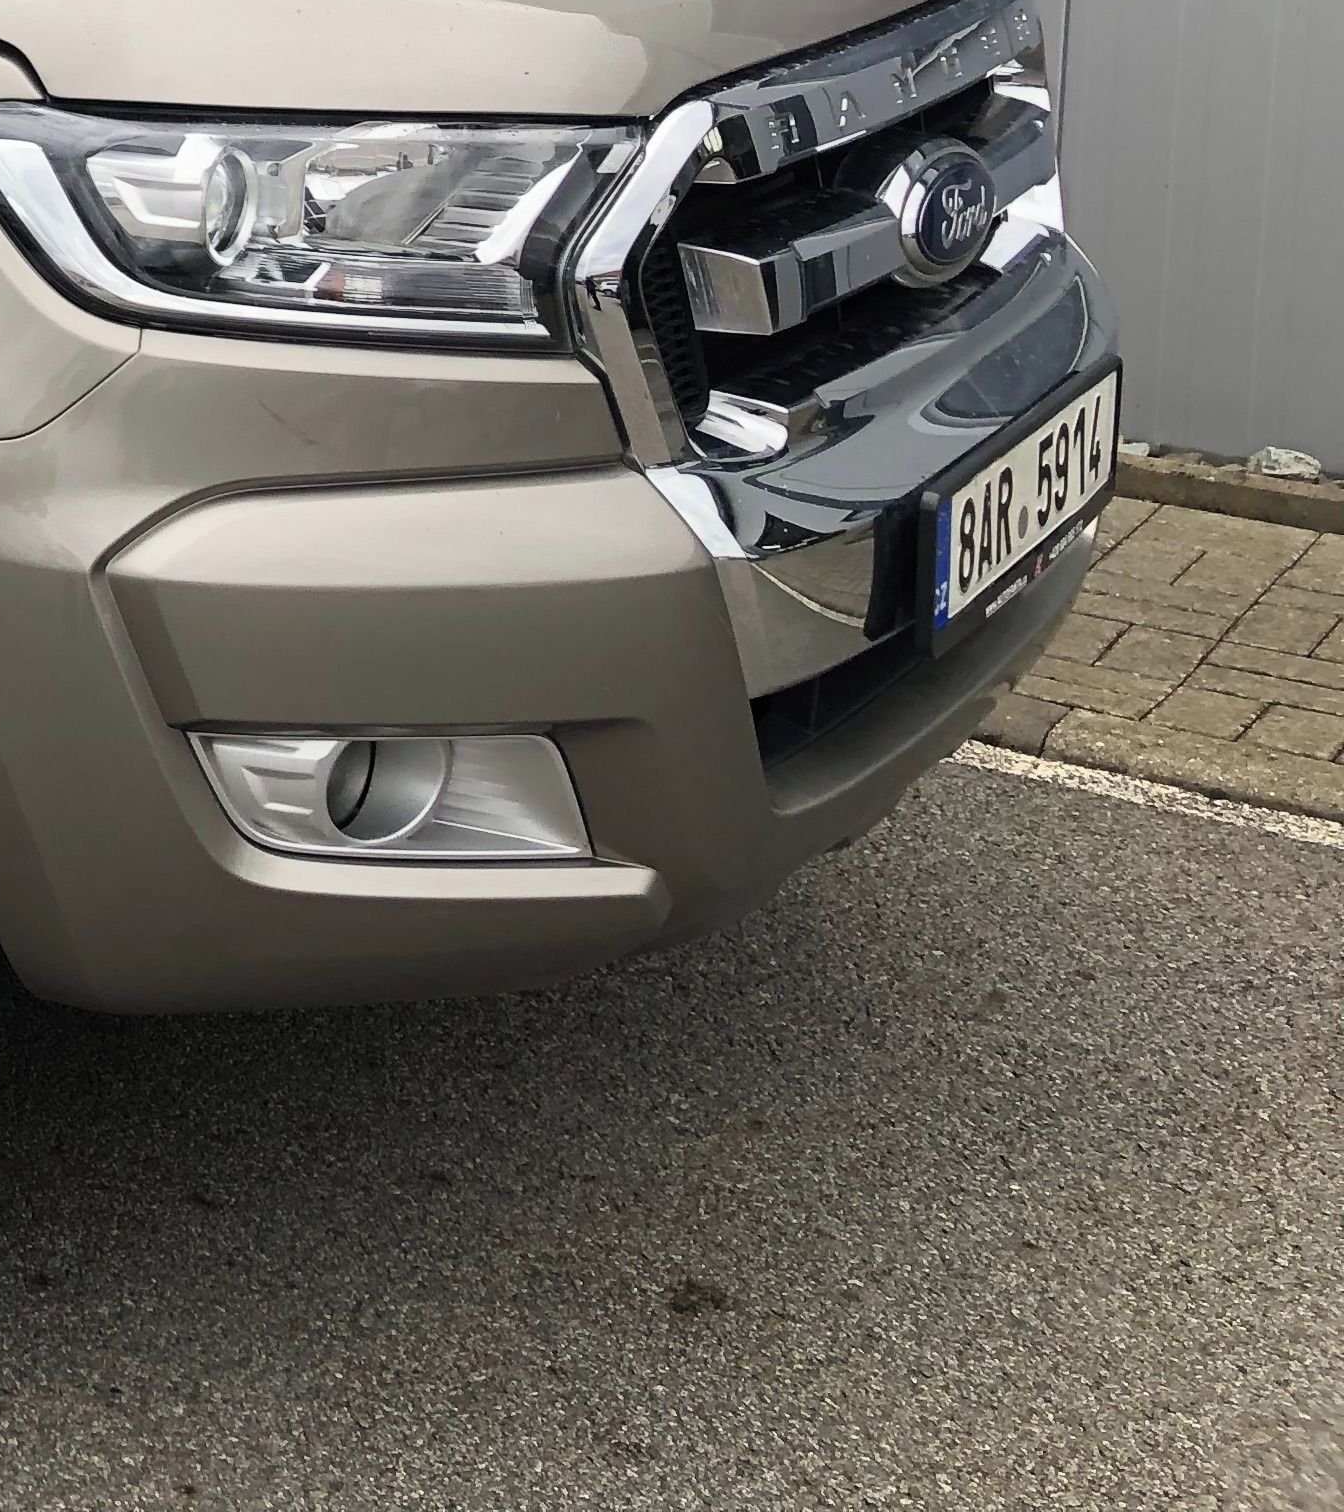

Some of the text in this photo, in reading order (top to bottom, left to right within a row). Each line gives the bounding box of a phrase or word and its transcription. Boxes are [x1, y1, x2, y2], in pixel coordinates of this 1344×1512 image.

[941, 179, 988, 250] Ford
[959, 395, 1102, 593] 8AR 5914
